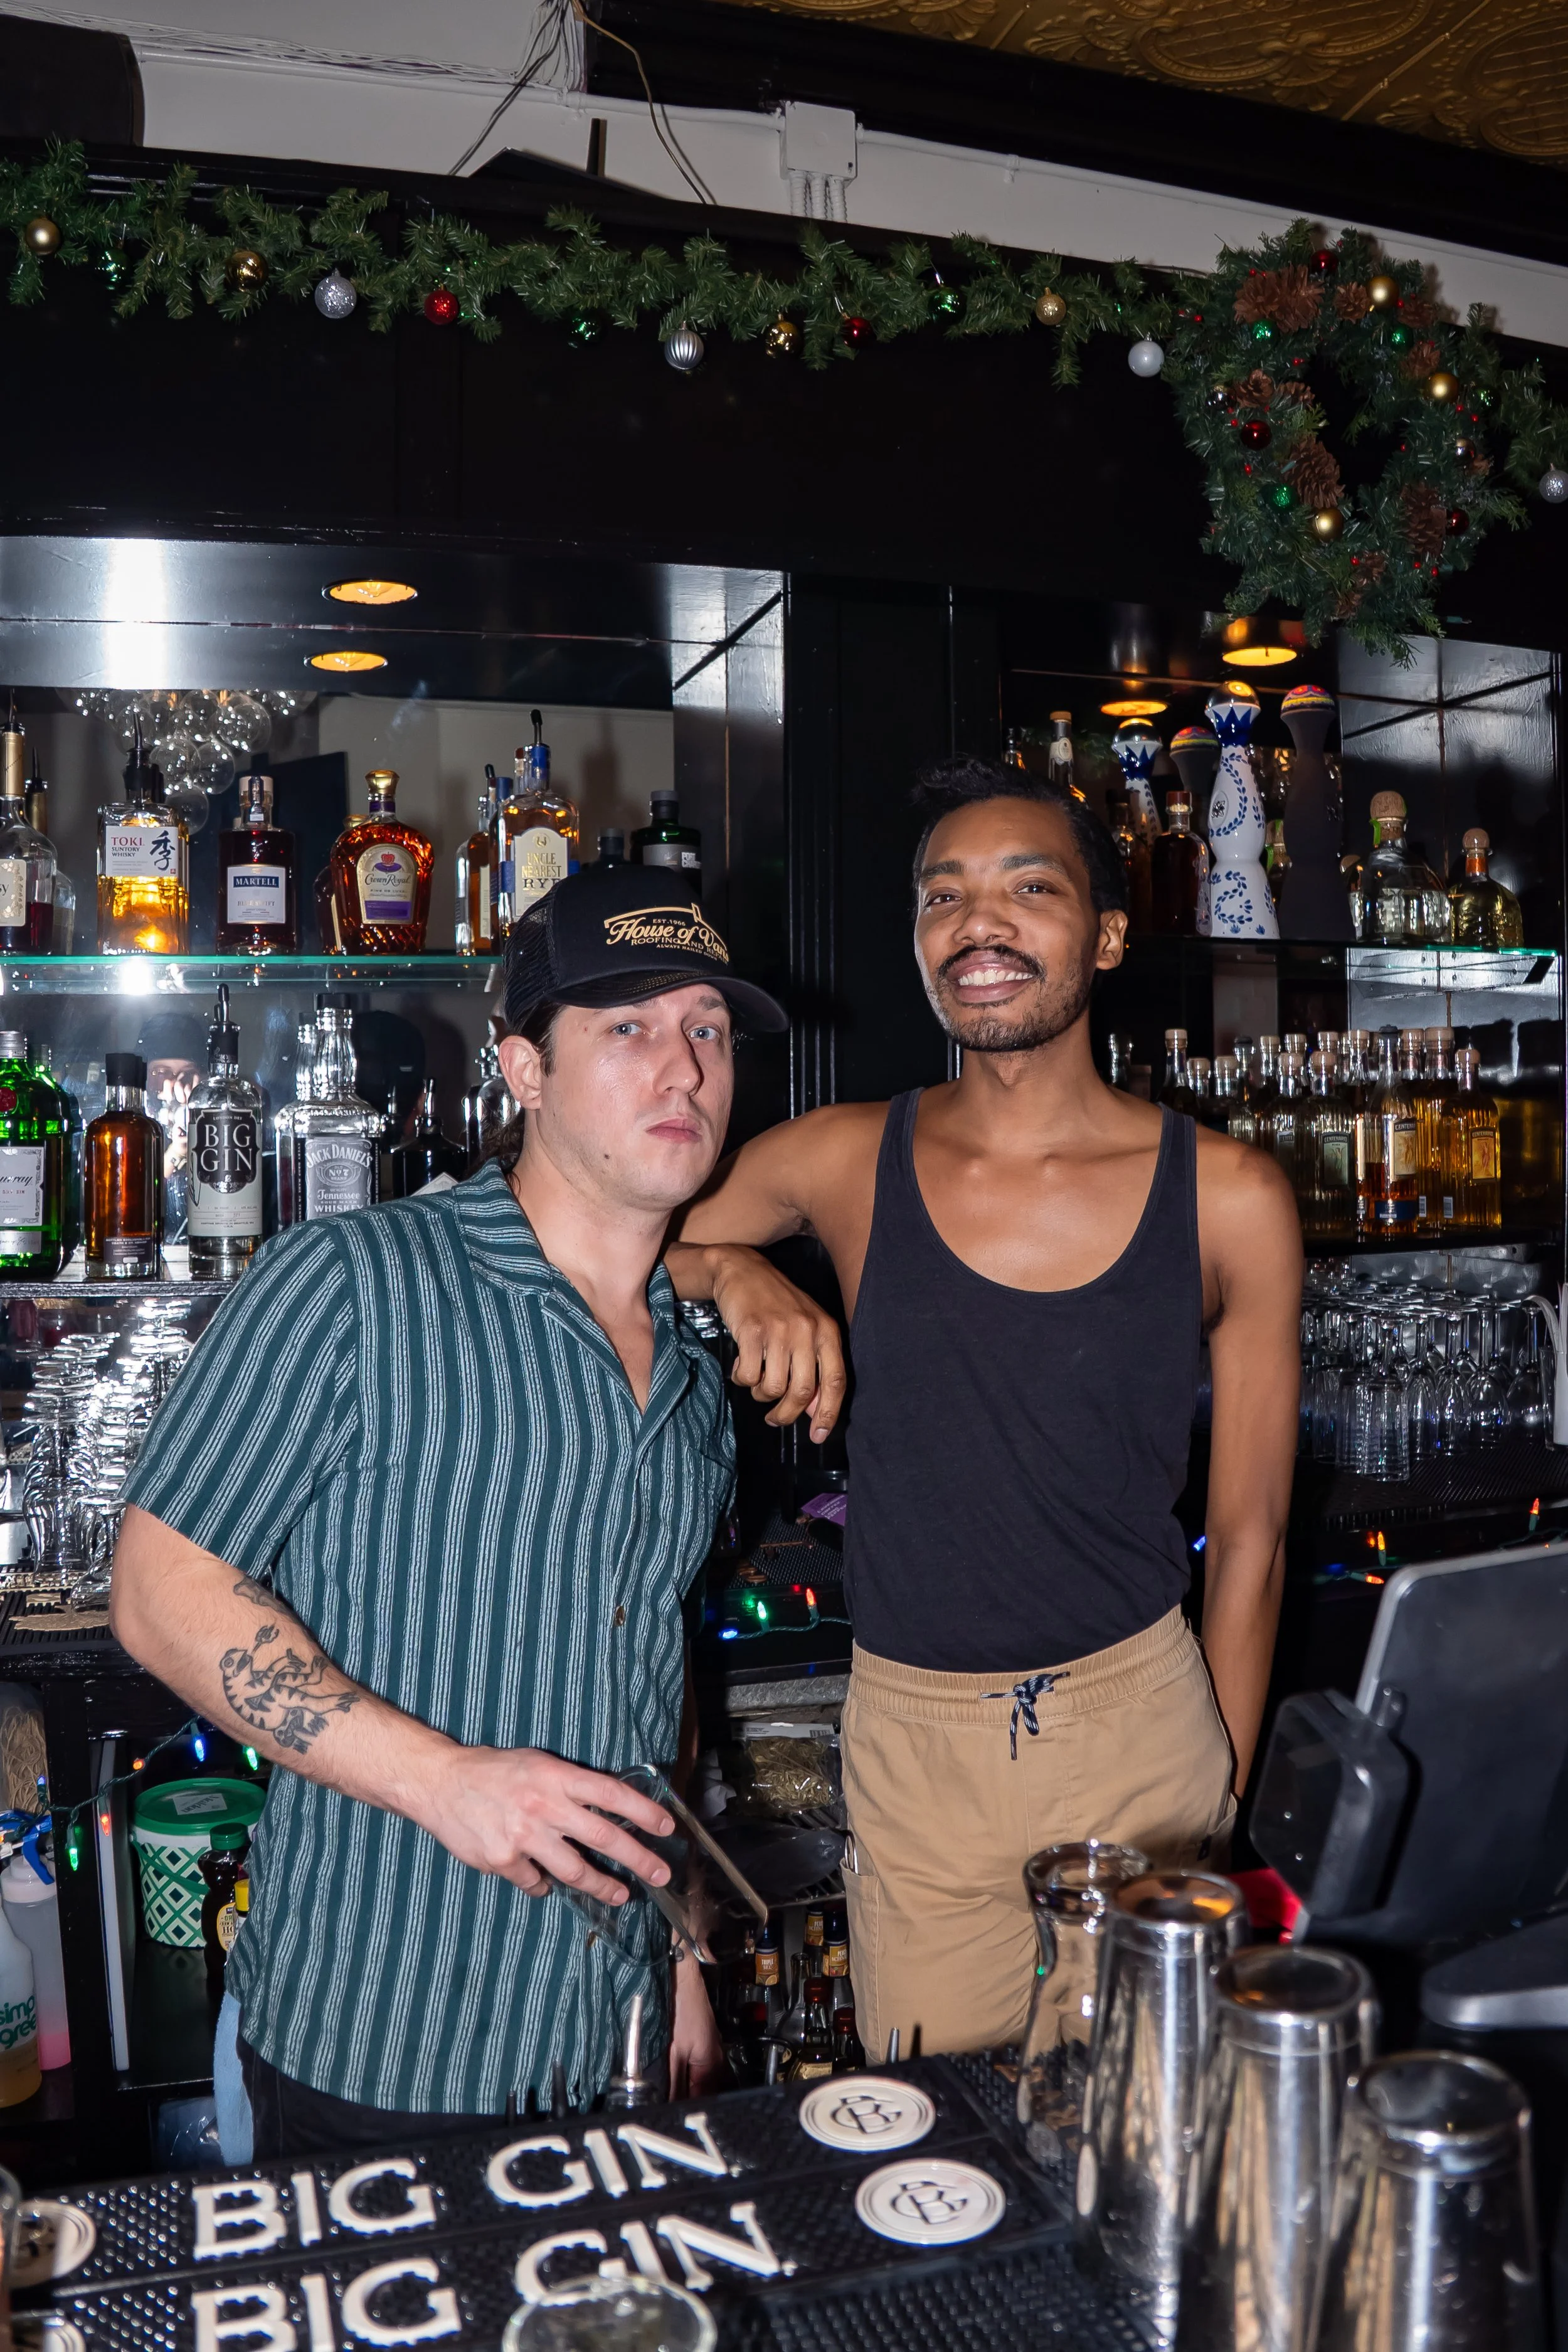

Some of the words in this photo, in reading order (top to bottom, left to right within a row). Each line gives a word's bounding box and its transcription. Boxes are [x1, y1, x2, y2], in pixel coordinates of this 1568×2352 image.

[111, 837, 143, 847] TOKI
[150, 830, 176, 871] 季
[527, 853, 556, 865] UNCLE
[522, 866, 562, 877] NEAREST
[606, 917, 674, 945] House
[677, 926, 699, 945] of
[631, 937, 679, 946] ROOFING
[682, 946, 702, 954] NAILED
[204, 1123, 251, 1148] BIG
[200, 1148, 252, 1172] GIN
[306, 1147, 331, 1168] JACK
[331, 1143, 373, 1168] DANIEL'S
[317, 1189, 360, 1200] Tennessee
[191, 2158, 437, 2260] BIG
[486, 2112, 729, 2208] GIN
[191, 2257, 462, 2352] BIG
[514, 2201, 780, 2307] GIN
